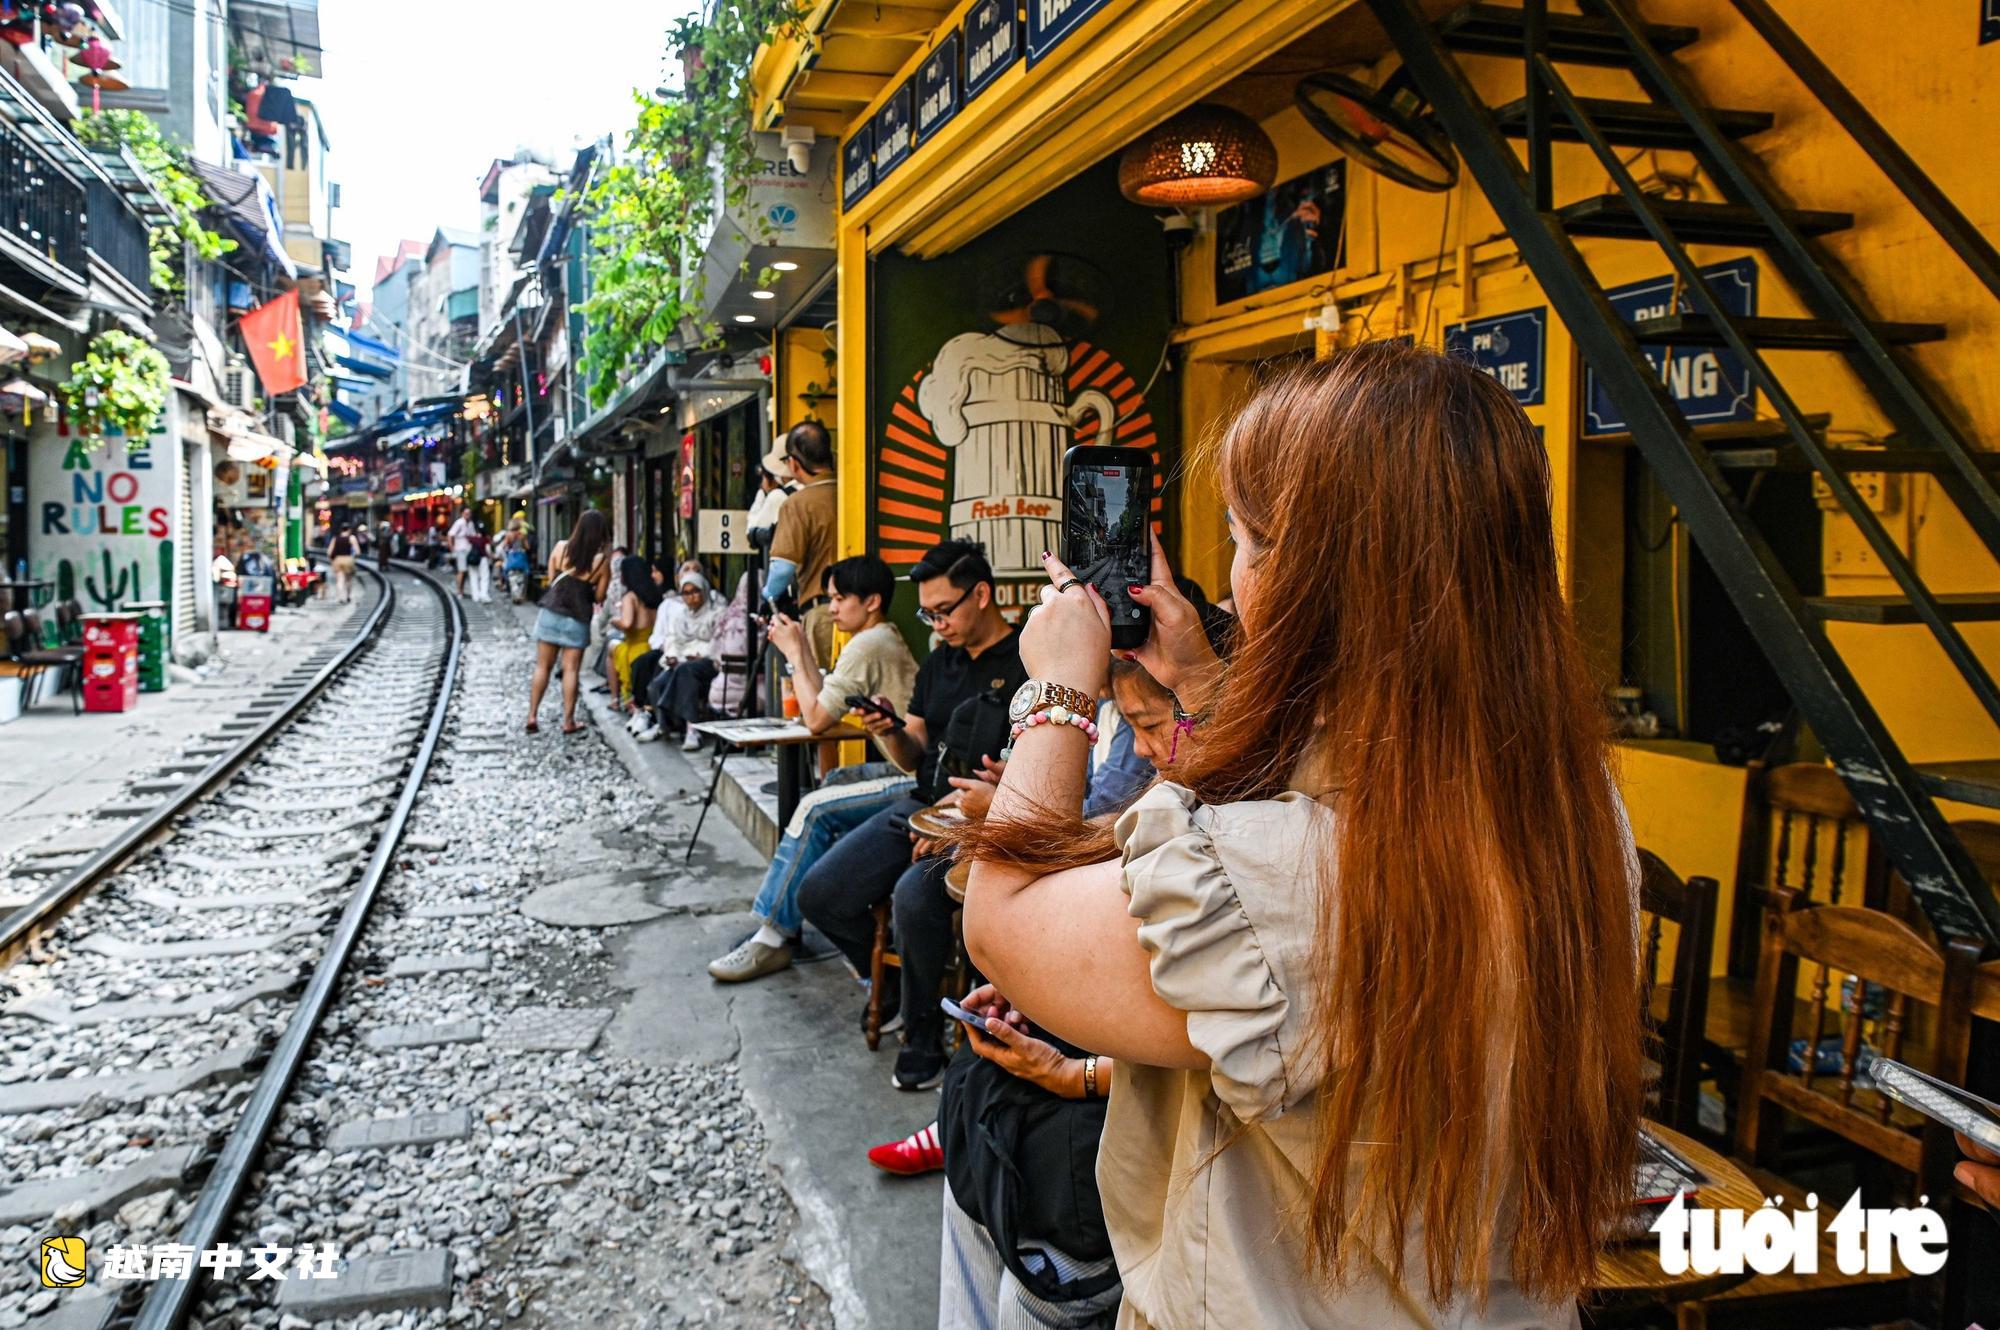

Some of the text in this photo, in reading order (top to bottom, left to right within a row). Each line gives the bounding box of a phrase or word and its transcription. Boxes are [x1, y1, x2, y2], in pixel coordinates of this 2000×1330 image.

[1645, 352, 1719, 400] NG
[62, 439, 153, 470] AE
[73, 471, 138, 504] NO
[42, 501, 169, 538] RULES
[972, 498, 1052, 520] Fresh Beer
